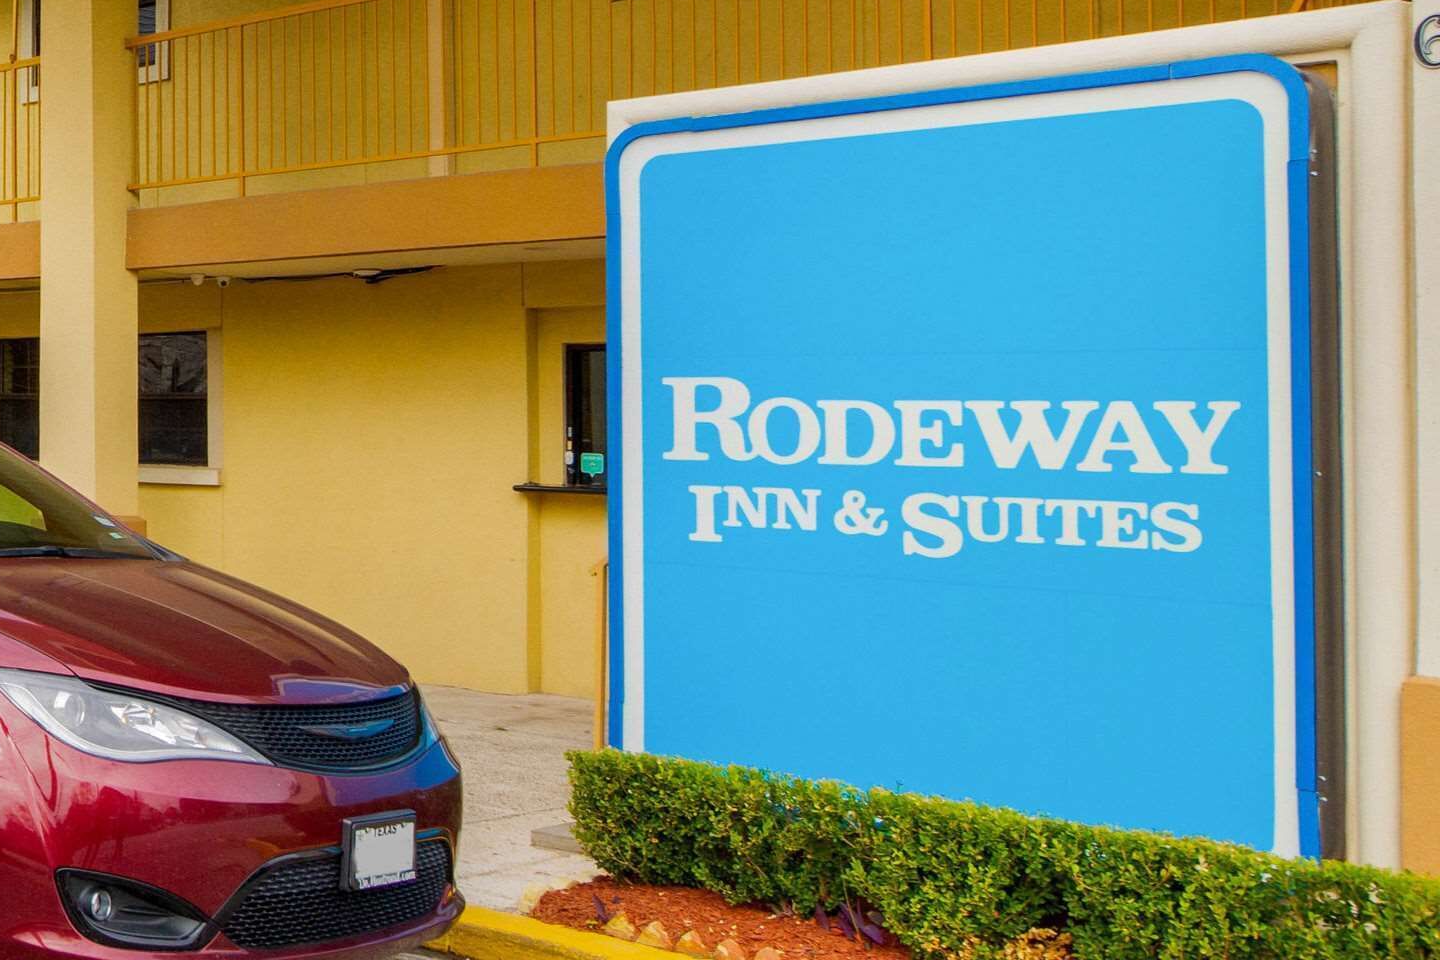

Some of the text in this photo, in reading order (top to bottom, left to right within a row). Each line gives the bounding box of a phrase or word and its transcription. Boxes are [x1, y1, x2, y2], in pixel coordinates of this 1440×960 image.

[662, 376, 1241, 474] RODEWAY
[688, 485, 1203, 558] INN & SUITES
[374, 826, 397, 837] TEXAS
